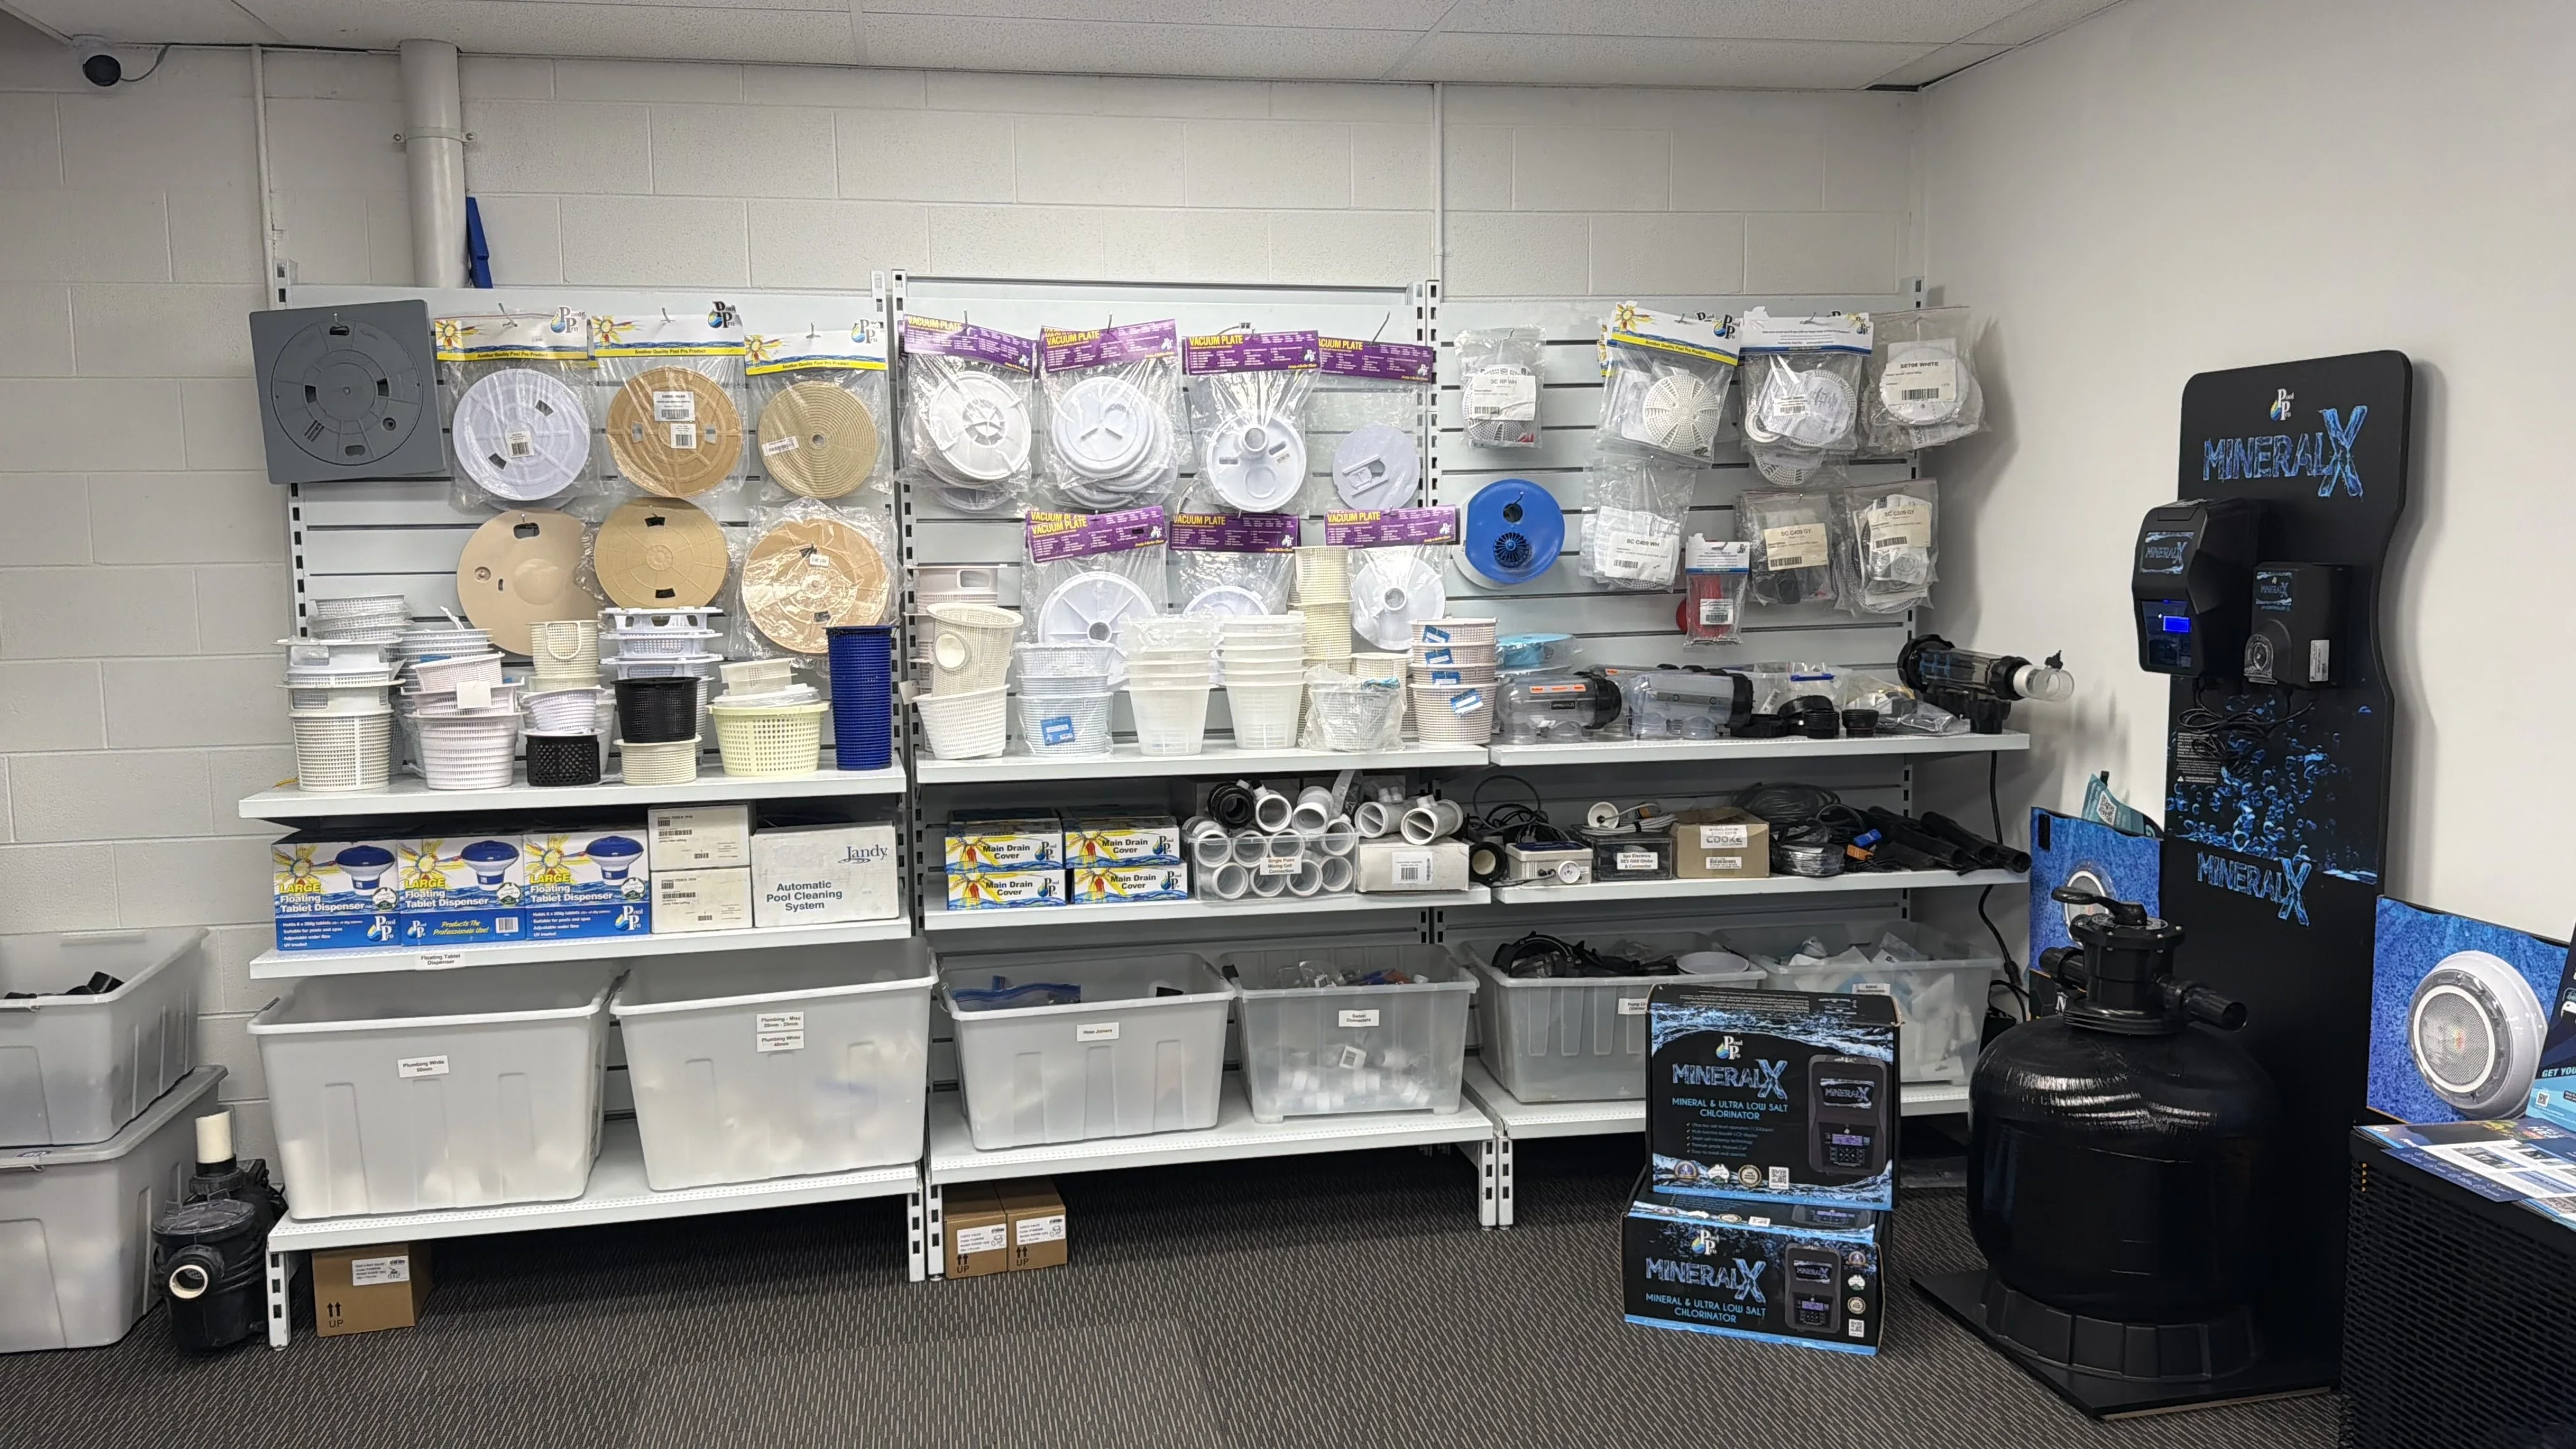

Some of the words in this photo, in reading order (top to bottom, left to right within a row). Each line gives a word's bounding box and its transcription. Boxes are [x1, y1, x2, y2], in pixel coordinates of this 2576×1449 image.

[721, 312, 735, 328] Pro
[908, 316, 939, 328] VACUUM
[940, 321, 962, 332] PLATE
[1725, 314, 1740, 328] Pool
[565, 319, 579, 333] Pro
[866, 330, 878, 344] Pro
[1726, 325, 1735, 339] Pro
[1046, 335, 1077, 346] VACUUM
[1078, 331, 1100, 341] PLATE
[1190, 337, 1220, 346] VACUUM
[1222, 335, 1243, 345] PLATE
[1342, 341, 1363, 350] PLATE
[2278, 388, 2294, 407] Pool
[2280, 401, 2291, 420] Pro
[1031, 512, 1064, 521] VACUUM
[1173, 516, 1202, 525] VACUUM
[1204, 516, 1225, 525] PLATE
[1327, 513, 1357, 523] VACUUM
[1359, 512, 1381, 521] PLATE
[1032, 523, 1063, 535] VACUUM
[1064, 519, 1087, 530] PLATE
[1041, 841, 1057, 852] Pool
[1159, 836, 1174, 847] Pool
[846, 845, 887, 862] Jandy
[1045, 848, 1055, 860] Pro
[1163, 843, 1172, 854] Pro
[530, 874, 571, 884] LARGE
[1167, 871, 1181, 882] Pool
[280, 882, 321, 893] LARGE
[404, 878, 445, 889] LARGE
[777, 881, 832, 891] Automatic
[1044, 878, 1059, 889] Pool
[1171, 878, 1179, 889] Pro
[405, 890, 445, 899] Floating
[530, 885, 571, 894] Floating
[1048, 885, 1057, 896] Pro
[280, 895, 321, 904] Floating
[564, 893, 613, 902] Dispenser
[767, 894, 790, 902] Pool
[794, 891, 843, 900] Cleaning
[280, 904, 312, 912] Tablet
[314, 903, 365, 913] Dispenser
[439, 898, 489, 908] Dispenser
[785, 902, 825, 912] System
[622, 905, 643, 919] Pool
[375, 916, 395, 929] Pool
[629, 915, 641, 931] Pro
[381, 926, 394, 941] Pro
[1724, 1036, 1743, 1050] Pool
[1729, 1045, 1741, 1060] Pro
[2542, 1069, 2559, 1078] GET
[1672, 1098, 1706, 1107] MINERAL
[1710, 1099, 1715, 1107] &
[1718, 1100, 1744, 1110] ULTRA
[1746, 1101, 1767, 1110] LOW
[1768, 1103, 1788, 1113] SALT
[1699, 1108, 1760, 1121] CHLORINATOR
[1699, 1229, 1719, 1245] Pool
[1705, 1239, 1717, 1255] Pro
[956, 1266, 970, 1274] UP
[1646, 1292, 1682, 1305] MINERAL
[1694, 1300, 1720, 1310] ULTRA
[1723, 1302, 1743, 1313] LOW
[1746, 1305, 1766, 1316] SALT
[1675, 1307, 1736, 1322] CHLORINATOR
[329, 1319, 344, 1328] UP
